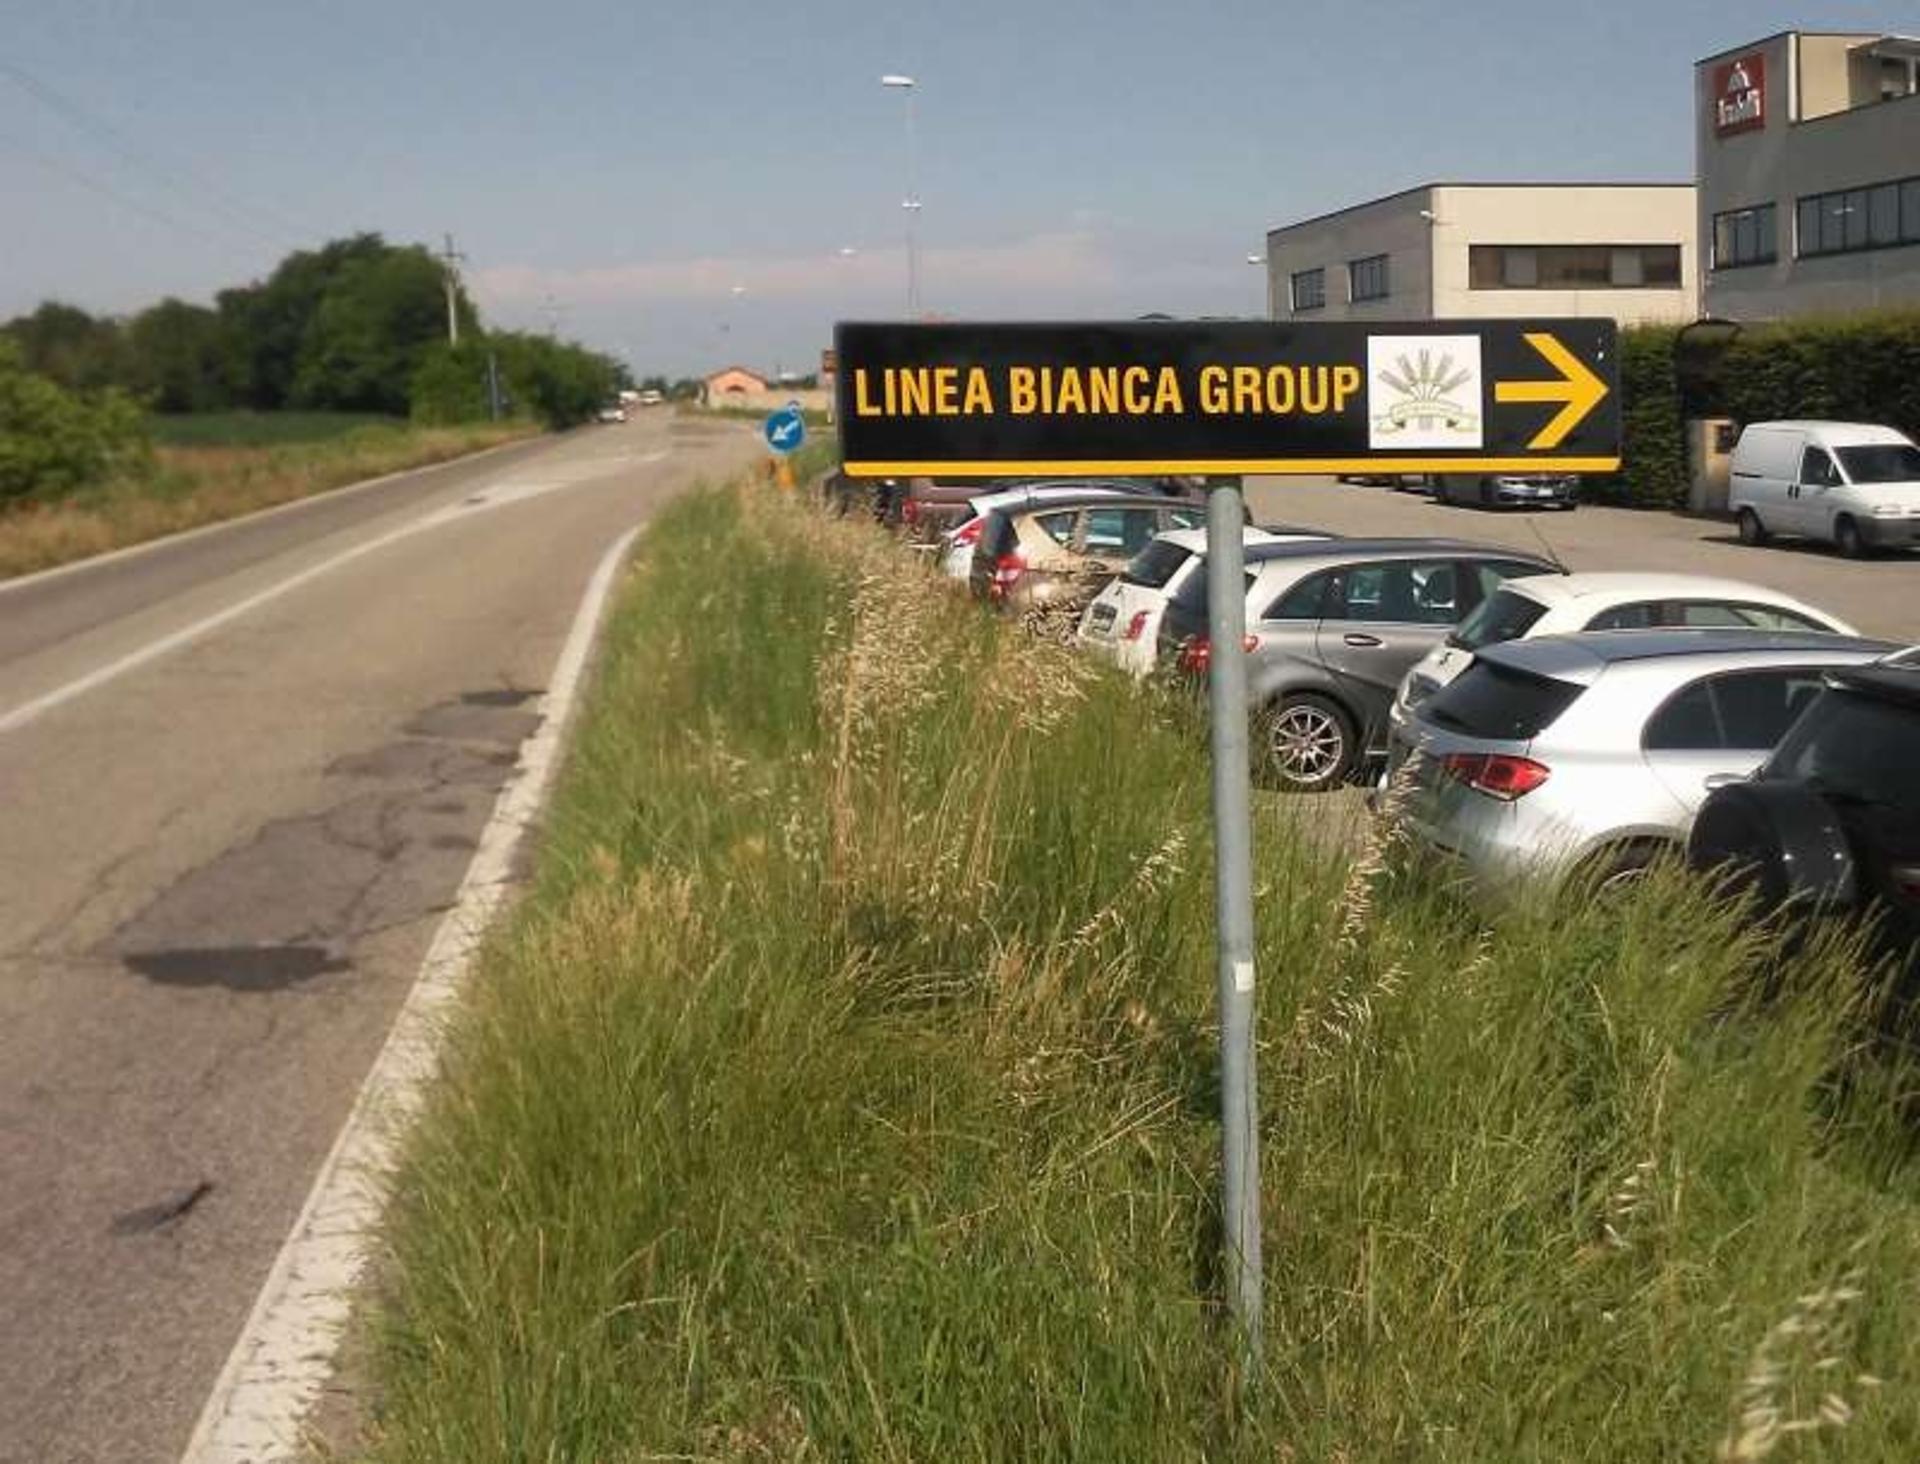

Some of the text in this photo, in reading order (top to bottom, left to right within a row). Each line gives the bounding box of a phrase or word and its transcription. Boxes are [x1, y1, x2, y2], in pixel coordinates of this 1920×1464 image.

[854, 364, 1361, 417] LINEA BIANCA GROUP
